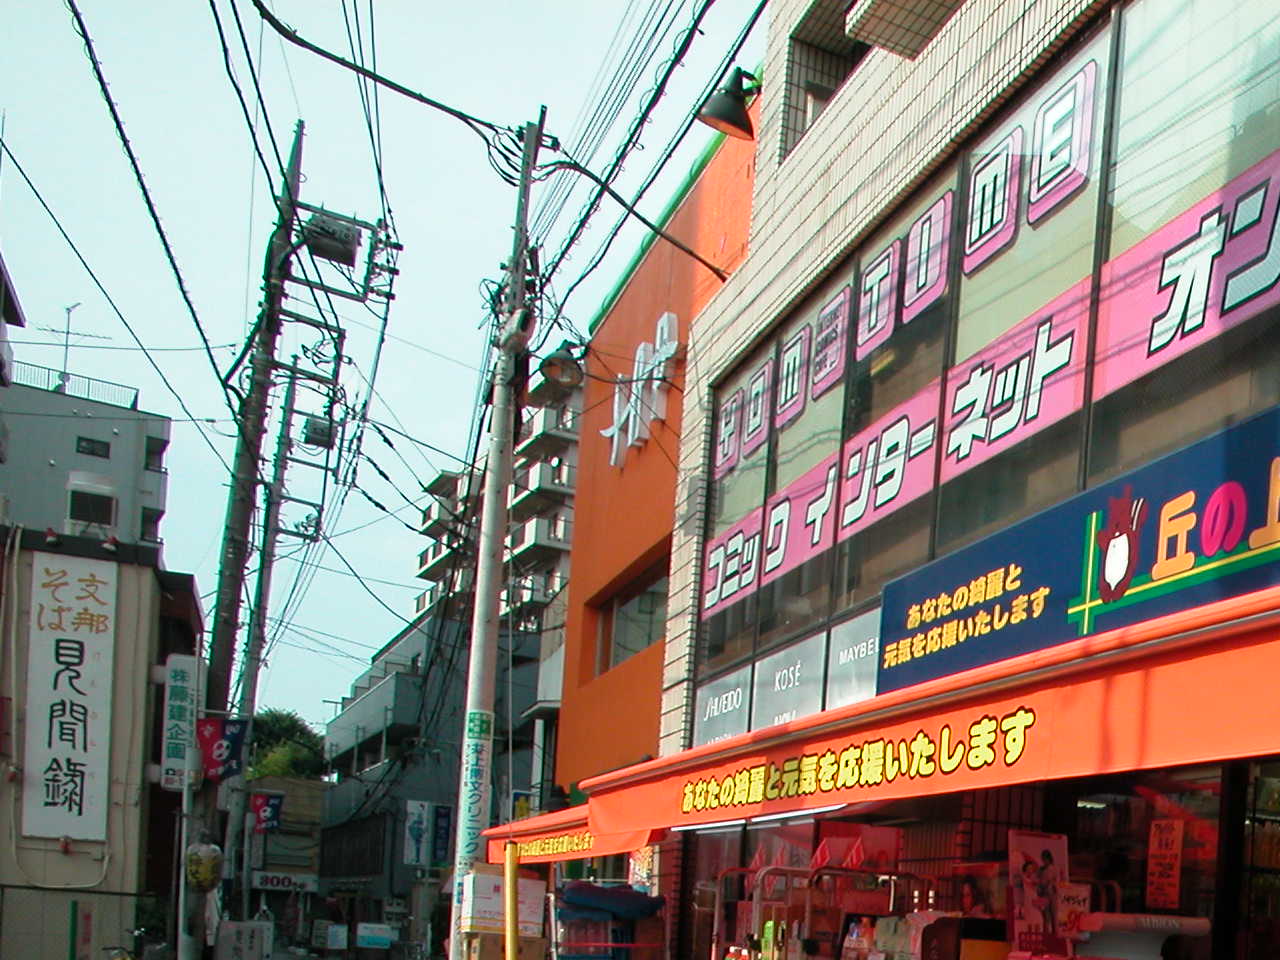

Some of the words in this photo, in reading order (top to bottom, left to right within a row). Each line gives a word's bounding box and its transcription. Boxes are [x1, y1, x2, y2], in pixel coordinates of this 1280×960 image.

[704, 497, 791, 610] コミック
[806, 320, 1074, 545] インターネット
[36, 567, 70, 632] そば
[883, 586, 1051, 668] 元気を応援いたします
[908, 562, 1024, 629] あなたの綺麗と
[682, 707, 1035, 813] あなたの綺麗と元気を応援いたします
